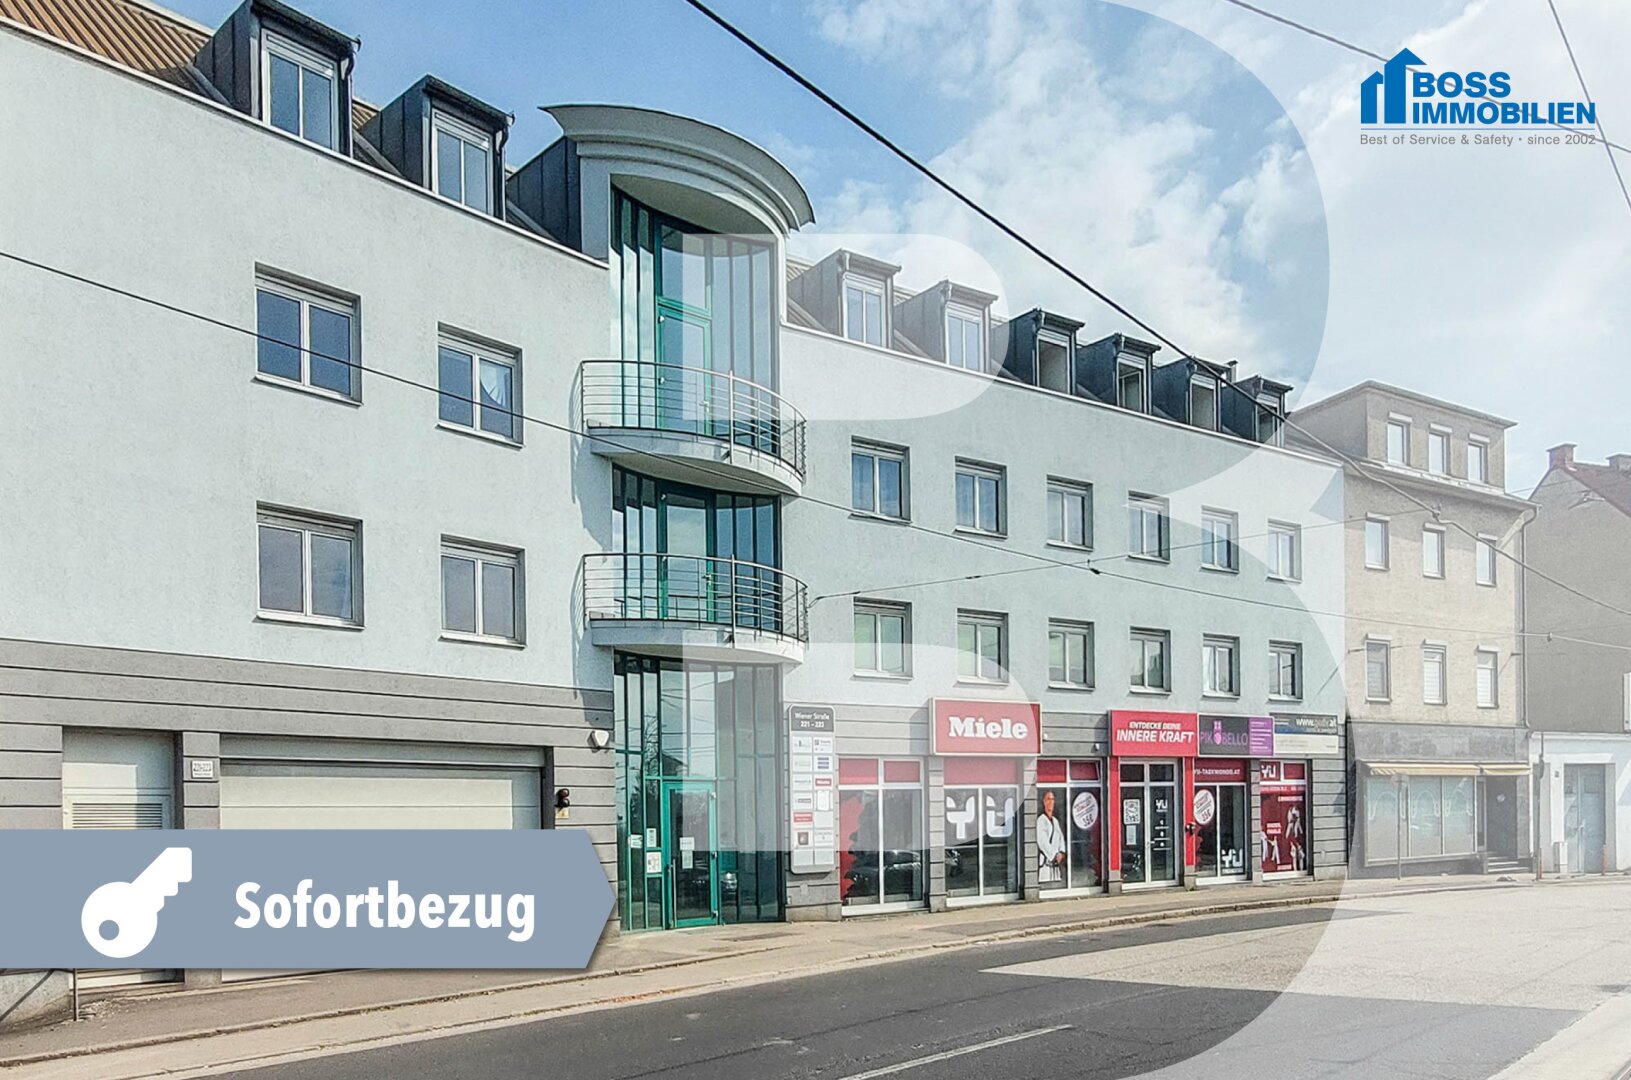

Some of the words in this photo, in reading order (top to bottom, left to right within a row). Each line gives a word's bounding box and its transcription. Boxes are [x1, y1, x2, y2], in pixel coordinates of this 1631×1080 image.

[948, 716, 1028, 739] Miele
[1129, 721, 1161, 730] ENTDECKE
[1162, 722, 1181, 730] DEINE
[1117, 730, 1157, 742] INNERE
[1158, 730, 1194, 743] KRAFT
